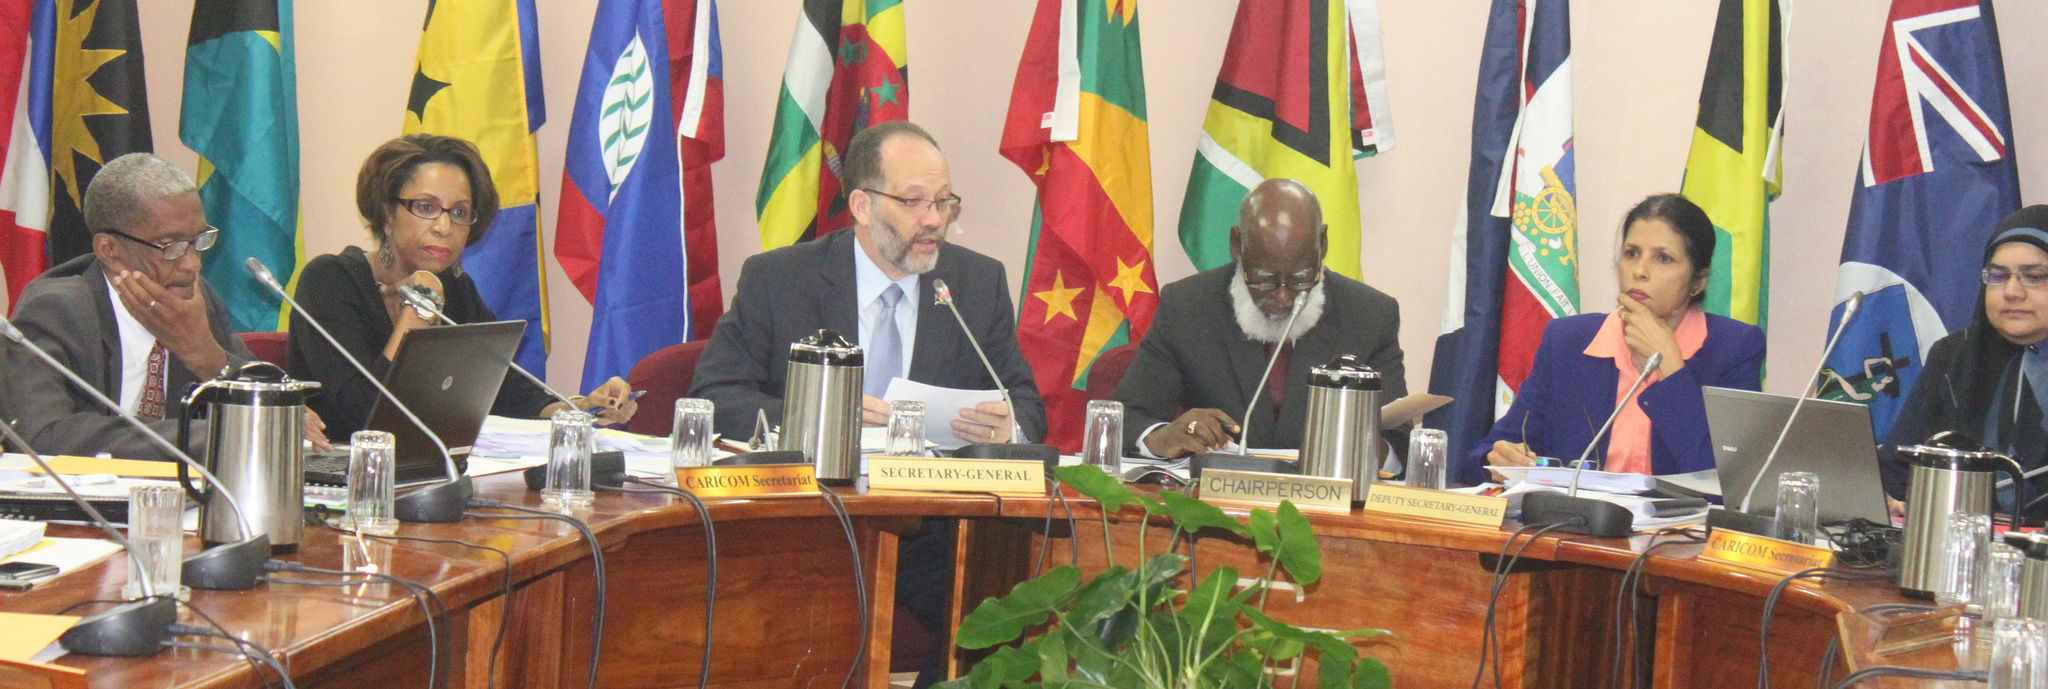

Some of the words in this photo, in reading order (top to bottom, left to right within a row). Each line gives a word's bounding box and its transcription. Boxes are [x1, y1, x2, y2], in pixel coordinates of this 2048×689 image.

[1523, 252, 1552, 288] L'UNION
[1551, 287, 1570, 308] FAIT
[686, 475, 750, 488] CARICOM
[752, 473, 812, 486] Secretariat
[881, 467, 1032, 481] SECRETARY-GENERAL
[1210, 478, 1341, 500] CHAIRPERSON
[1370, 494, 1405, 506] DEPUTY
[1407, 498, 1499, 517] SECRETARY-GENERAL
[1711, 537, 1768, 558] CARICOM
[1769, 547, 1823, 568] Secretariat
